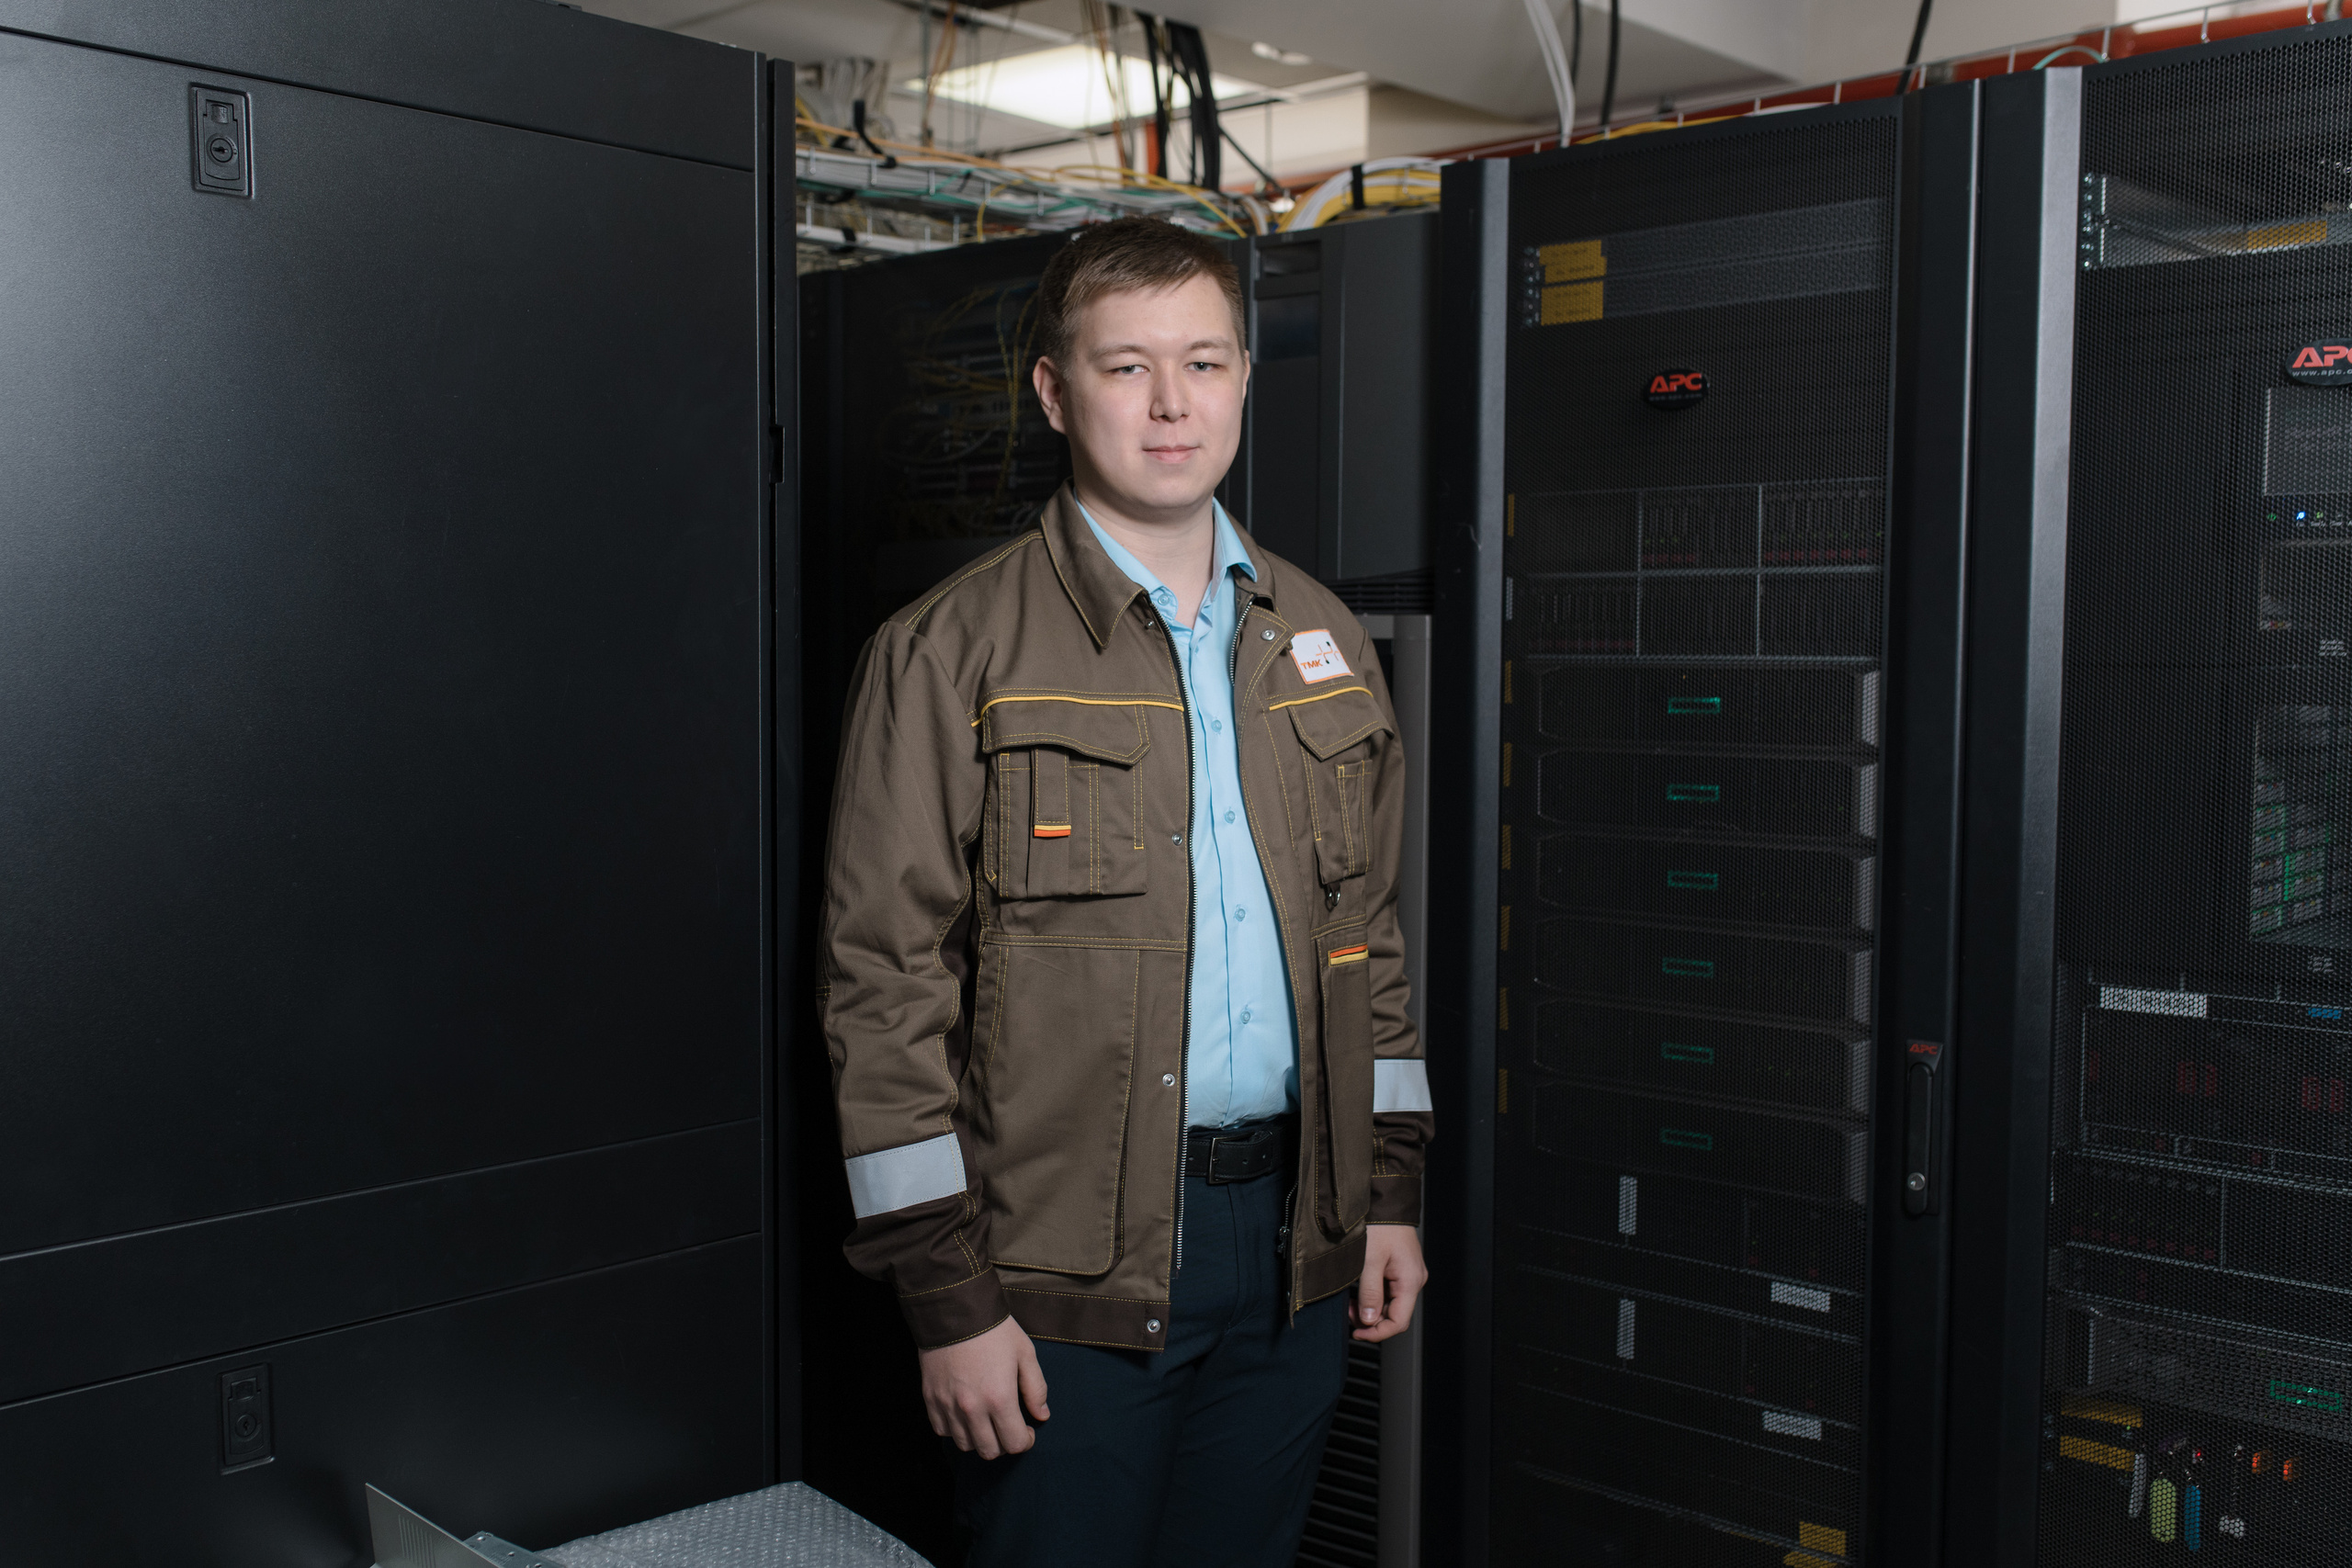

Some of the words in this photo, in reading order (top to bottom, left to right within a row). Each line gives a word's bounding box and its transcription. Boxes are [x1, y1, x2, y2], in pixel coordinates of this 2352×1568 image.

[2291, 345, 2352, 368] AP
[1650, 372, 1702, 393] APC
[1300, 660, 1323, 670] TMK
[1909, 1043, 1938, 1055] APC
